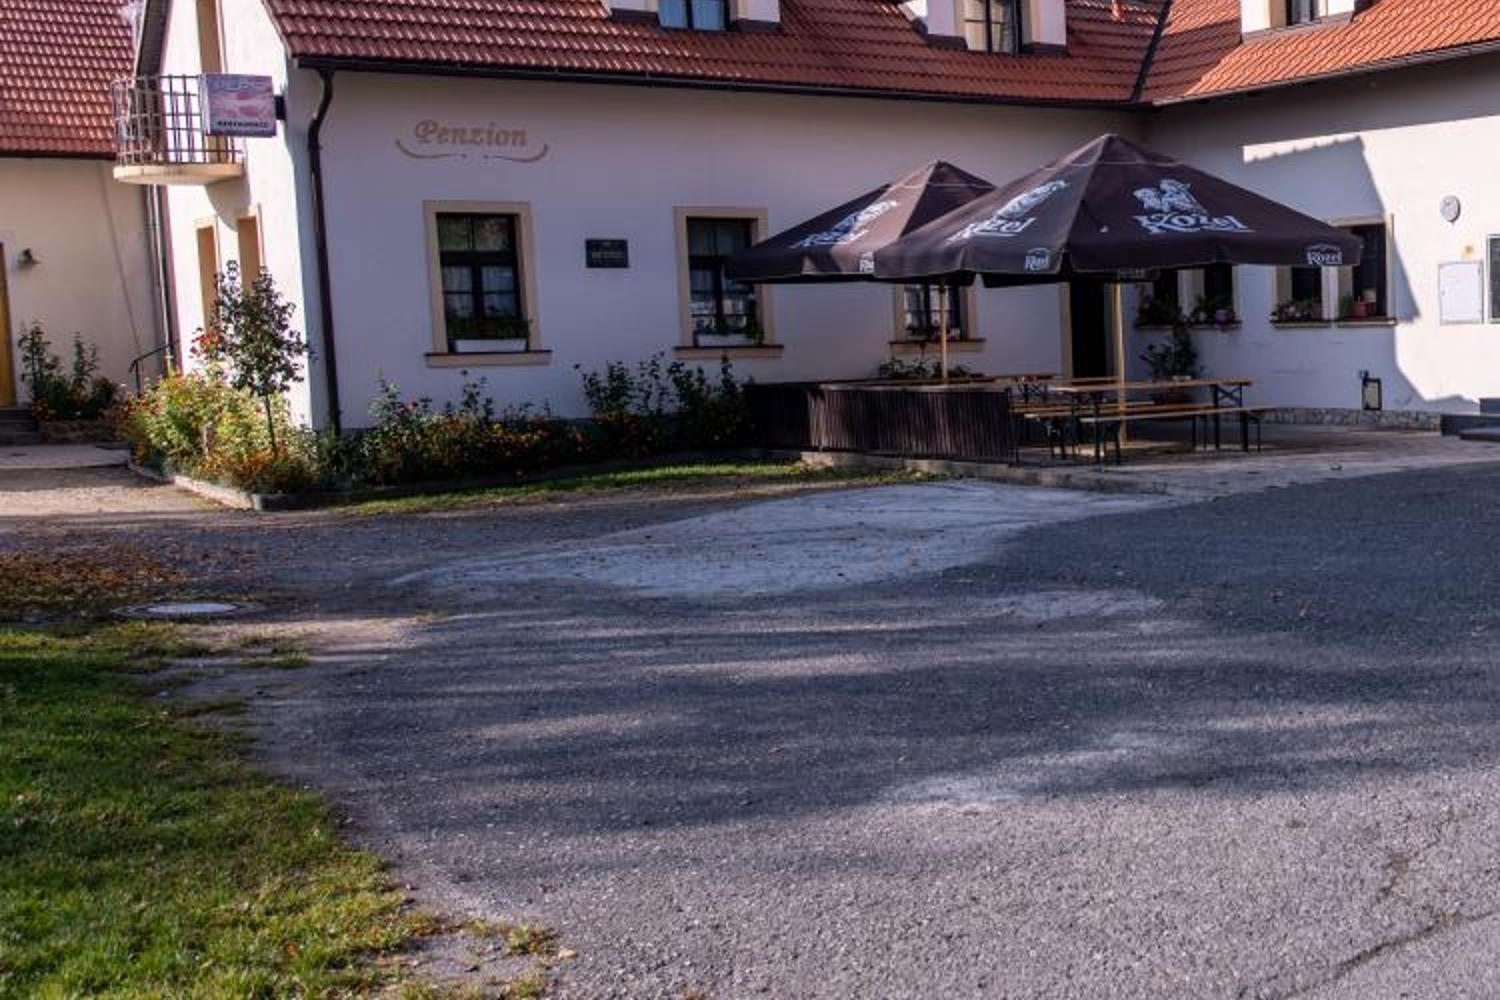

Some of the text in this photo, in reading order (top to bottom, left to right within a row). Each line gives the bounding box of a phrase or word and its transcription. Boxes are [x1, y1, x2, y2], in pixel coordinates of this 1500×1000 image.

[415, 118, 528, 147] Penzion
[1131, 213, 1256, 236] Kozel
[1307, 251, 1343, 266] Kozel
